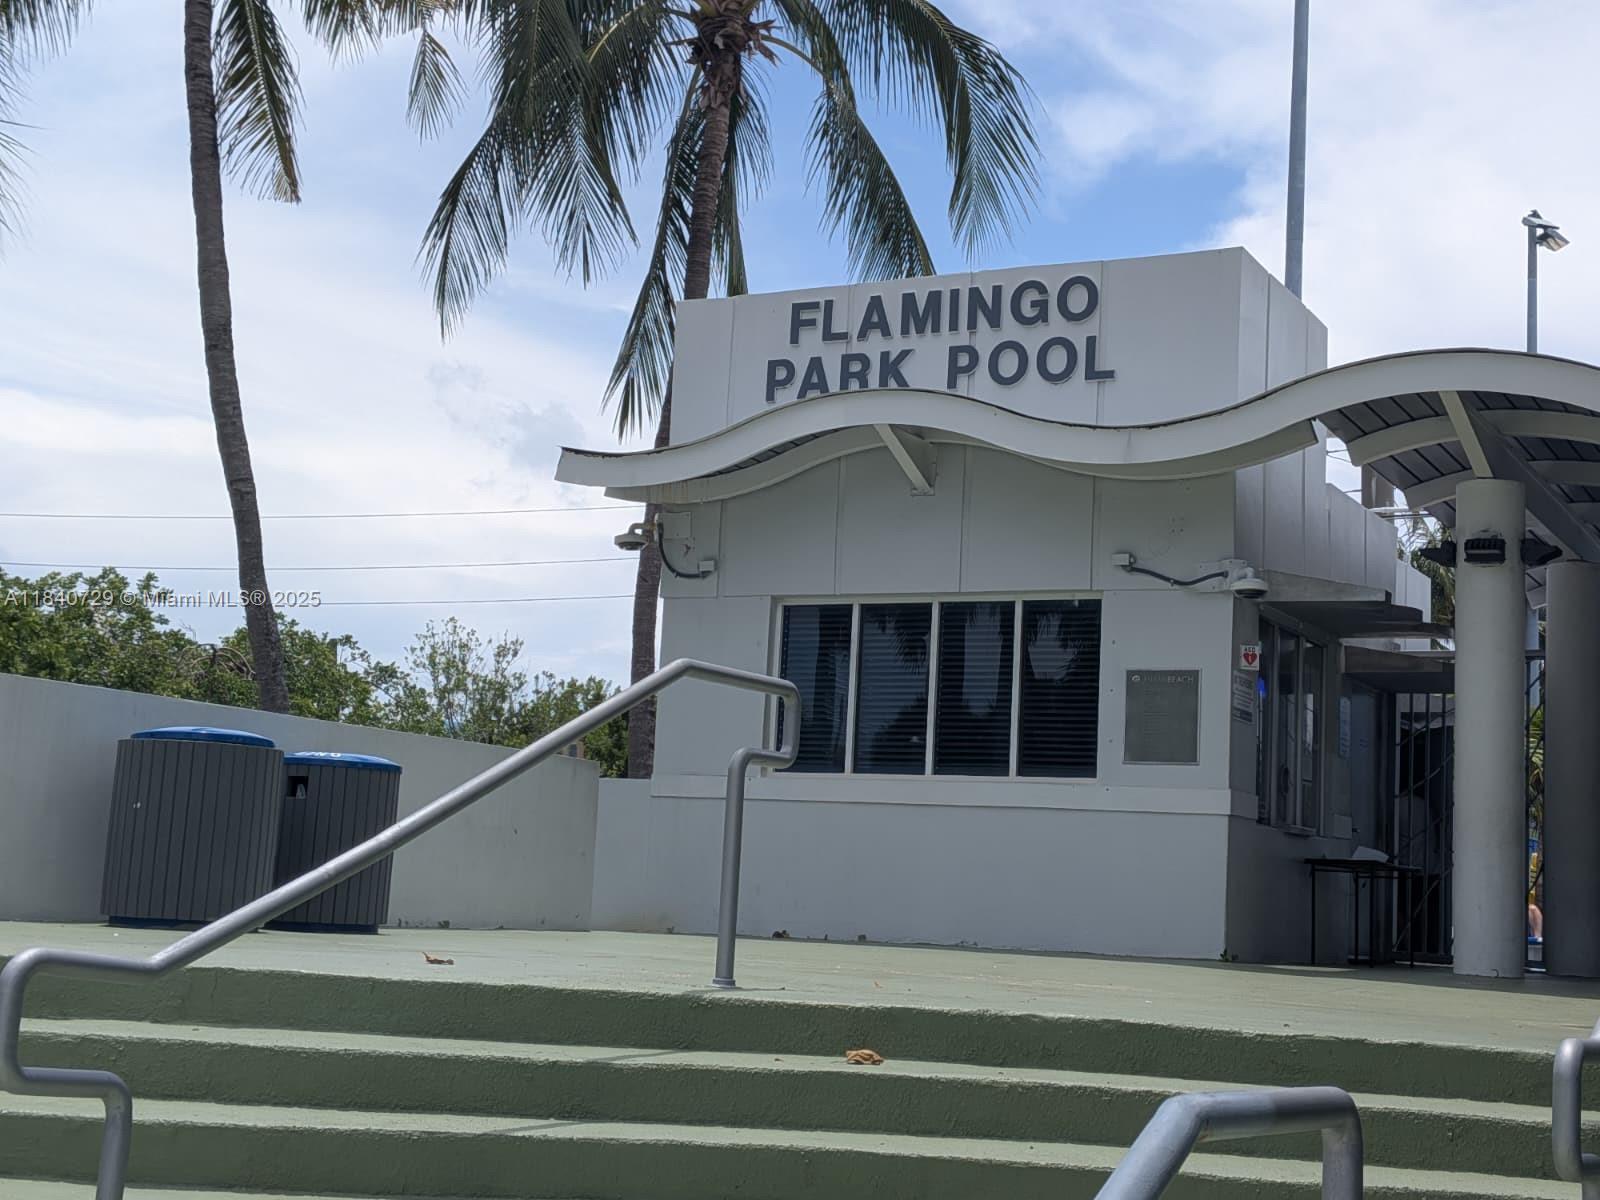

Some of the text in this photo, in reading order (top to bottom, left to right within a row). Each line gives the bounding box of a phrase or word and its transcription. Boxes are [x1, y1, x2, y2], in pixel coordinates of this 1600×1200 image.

[789, 275, 1099, 346] FLAMINGO
[765, 335, 1116, 403] PARK POOL
